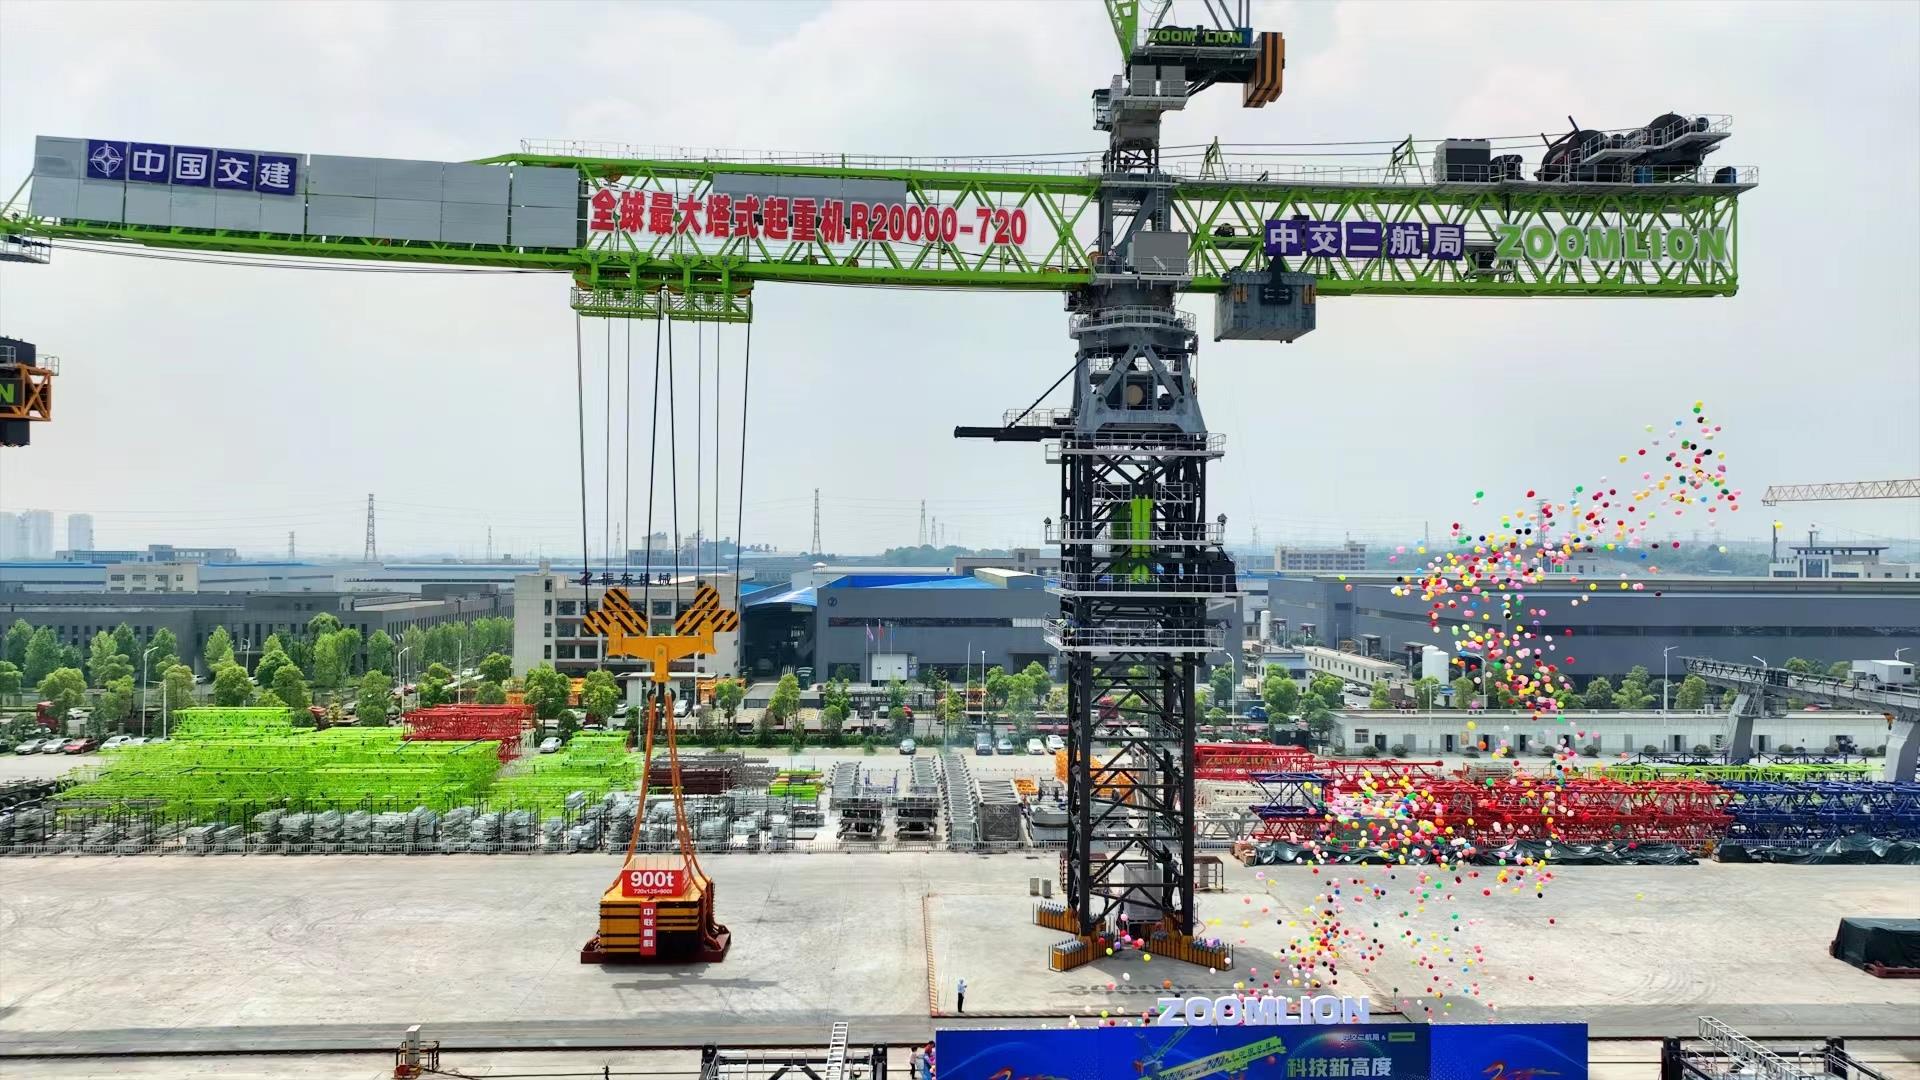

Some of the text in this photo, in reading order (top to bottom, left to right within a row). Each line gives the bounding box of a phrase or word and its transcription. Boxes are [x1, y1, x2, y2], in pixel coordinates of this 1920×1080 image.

[133, 148, 291, 190] 中国交建
[589, 188, 1028, 246] 全球最大塔式起重机R20000-720
[1269, 223, 1464, 260] 中交二航局
[1495, 223, 1727, 263] ZOOMLION
[630, 871, 674, 887] 900t
[1157, 995, 1370, 1025] ZOOMLION
[1287, 1056, 1392, 1077] 科技新高度
